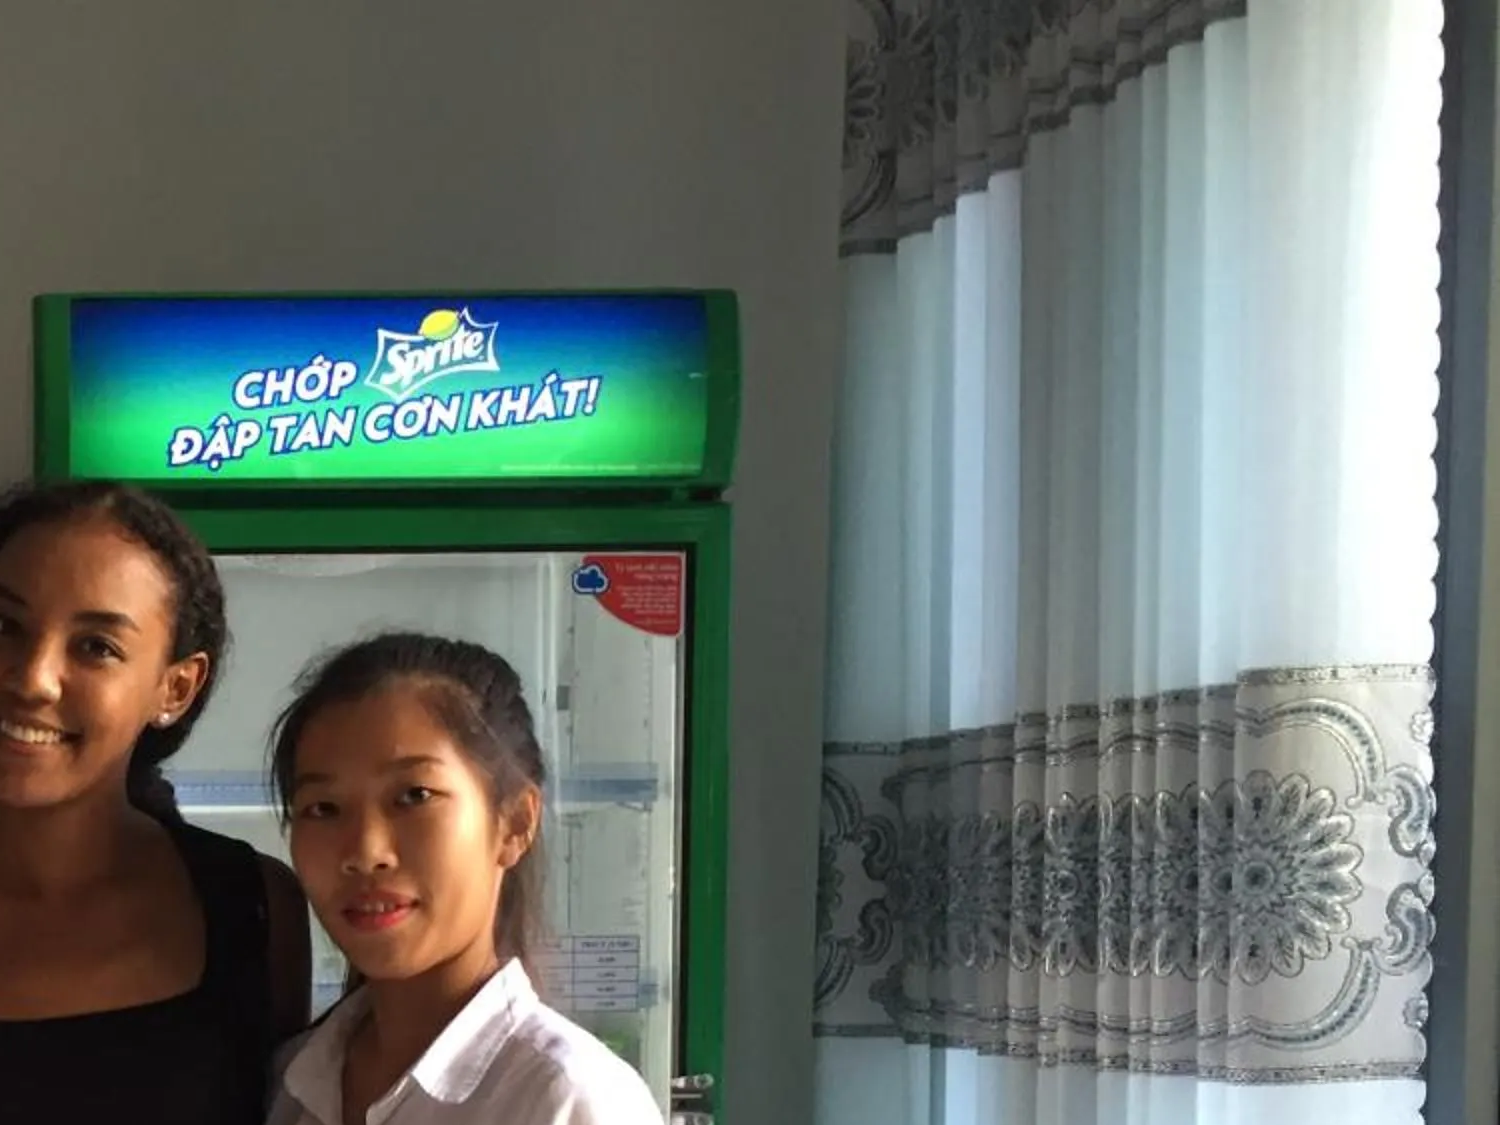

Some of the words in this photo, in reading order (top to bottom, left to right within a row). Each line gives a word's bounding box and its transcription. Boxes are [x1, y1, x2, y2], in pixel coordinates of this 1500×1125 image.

[233, 354, 357, 409] CHỚP
[380, 325, 484, 386] Sprite
[169, 413, 262, 471] ĐẬP
[268, 405, 359, 455] TAN
[363, 393, 463, 443] CƠN
[464, 369, 602, 432] KHÁT!
